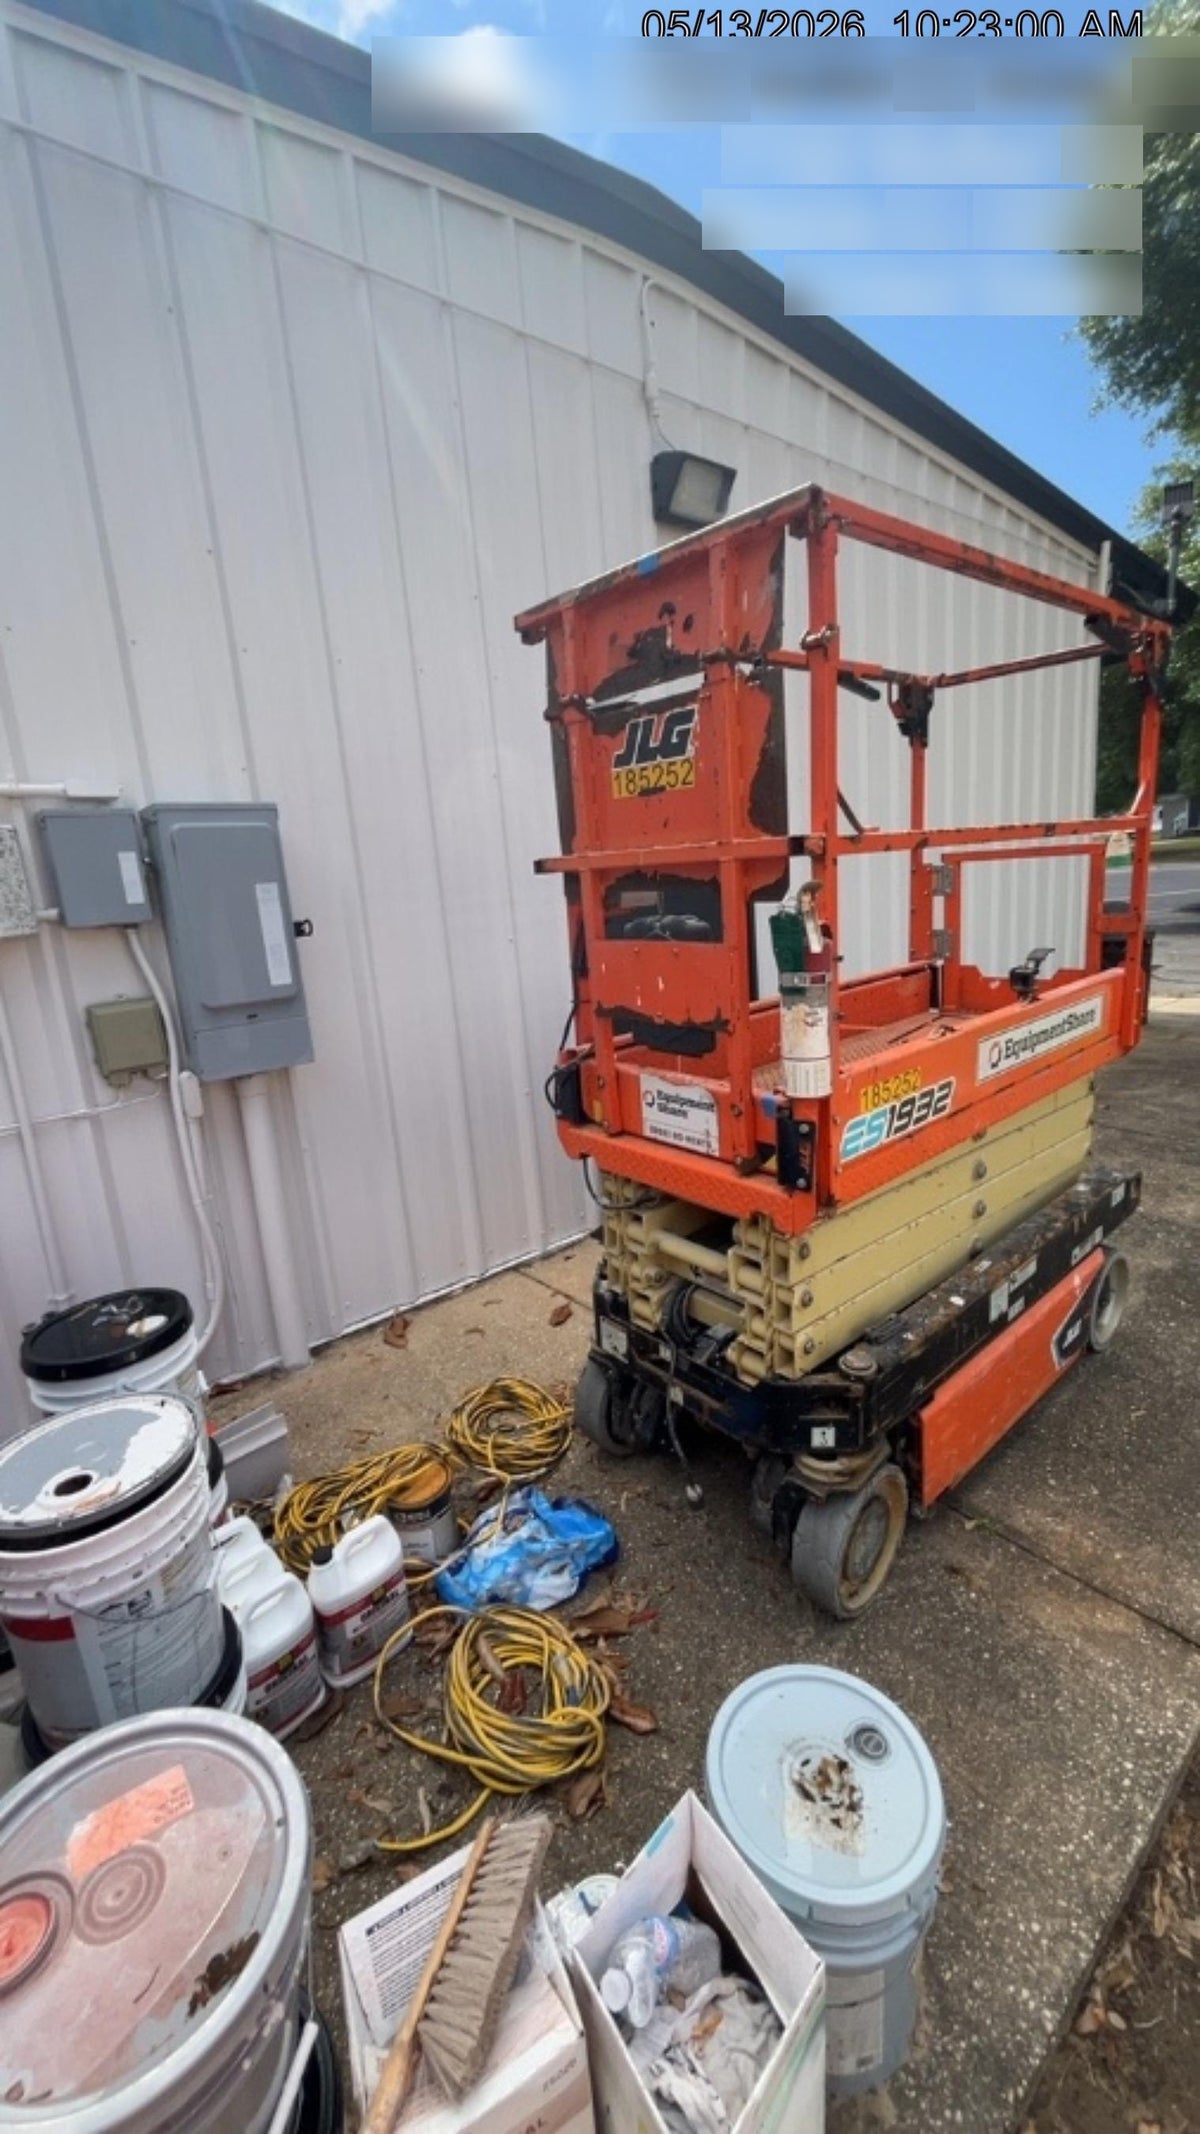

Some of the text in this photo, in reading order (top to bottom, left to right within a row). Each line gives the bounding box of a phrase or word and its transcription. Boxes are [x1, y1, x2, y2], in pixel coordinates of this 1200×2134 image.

[612, 704, 698, 769] JLG
[613, 759, 694, 796] 185252
[1003, 1008, 1095, 1060] EquipmentShare
[861, 1068, 920, 1110] 185252
[840, 1077, 955, 1161] ES1932
